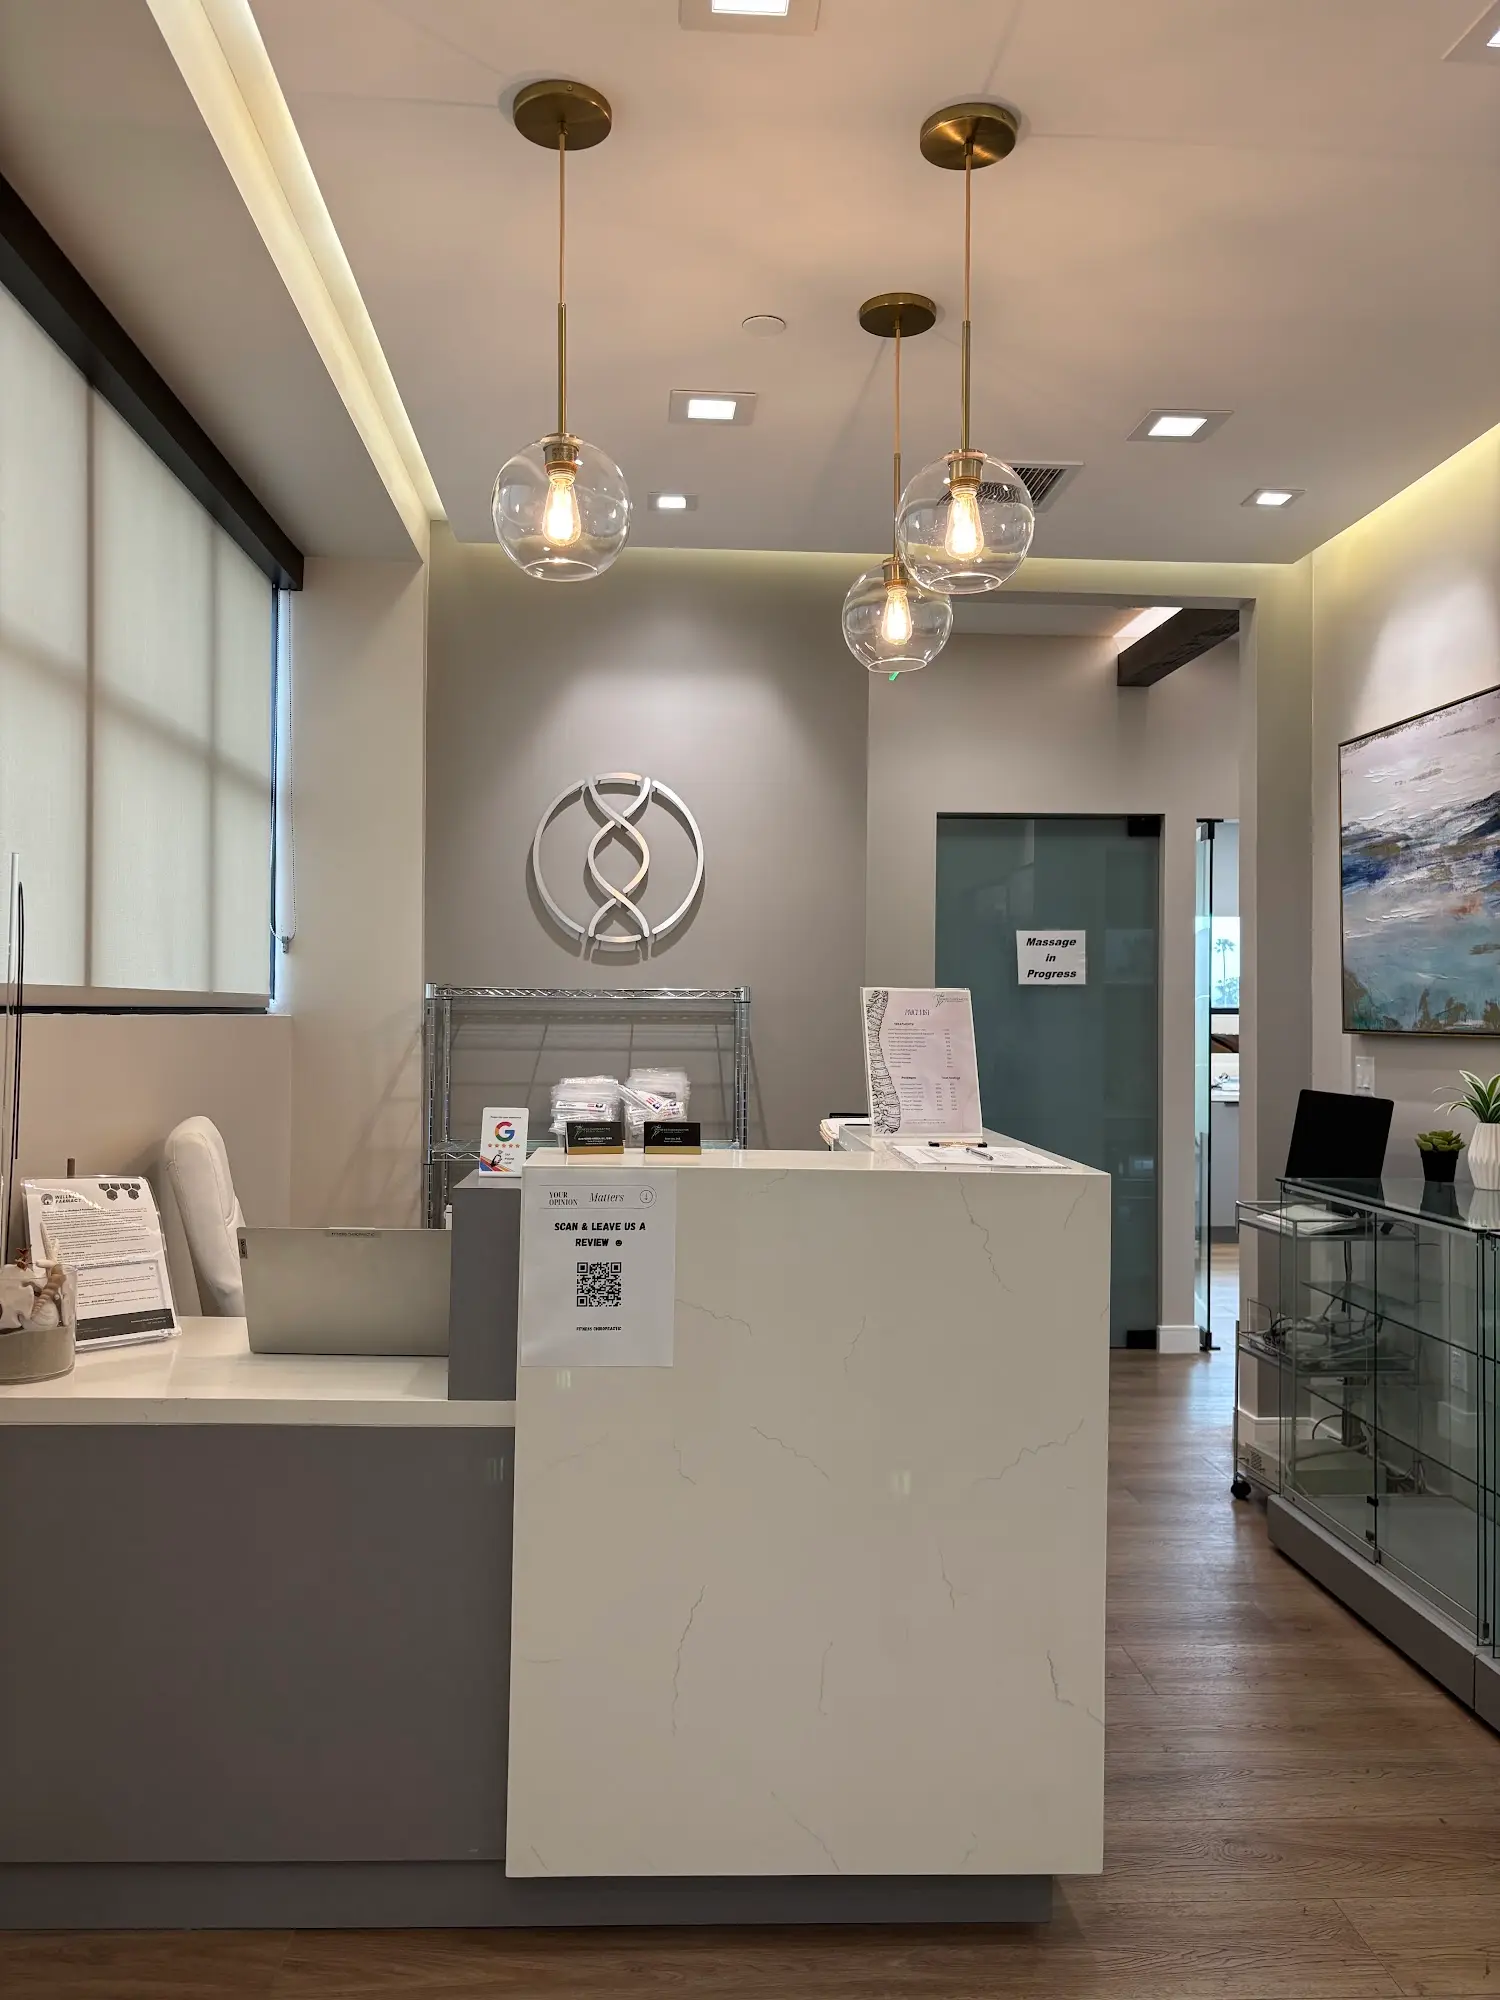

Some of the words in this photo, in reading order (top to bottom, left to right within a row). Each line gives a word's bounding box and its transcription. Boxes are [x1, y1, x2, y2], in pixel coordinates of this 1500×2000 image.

[1026, 937, 1077, 948] Massage
[1045, 953, 1056, 962] in
[1027, 969, 1077, 980] Progress
[549, 1191, 568, 1199] YOUR
[588, 1192, 624, 1203] Matters
[548, 1198, 578, 1206] OPINION
[554, 1222, 579, 1231] SCAN
[581, 1222, 588, 1231] &
[591, 1222, 621, 1231] LEAVE
[624, 1222, 636, 1231] US
[639, 1222, 646, 1231] A
[575, 1238, 609, 1247] REVIEW
